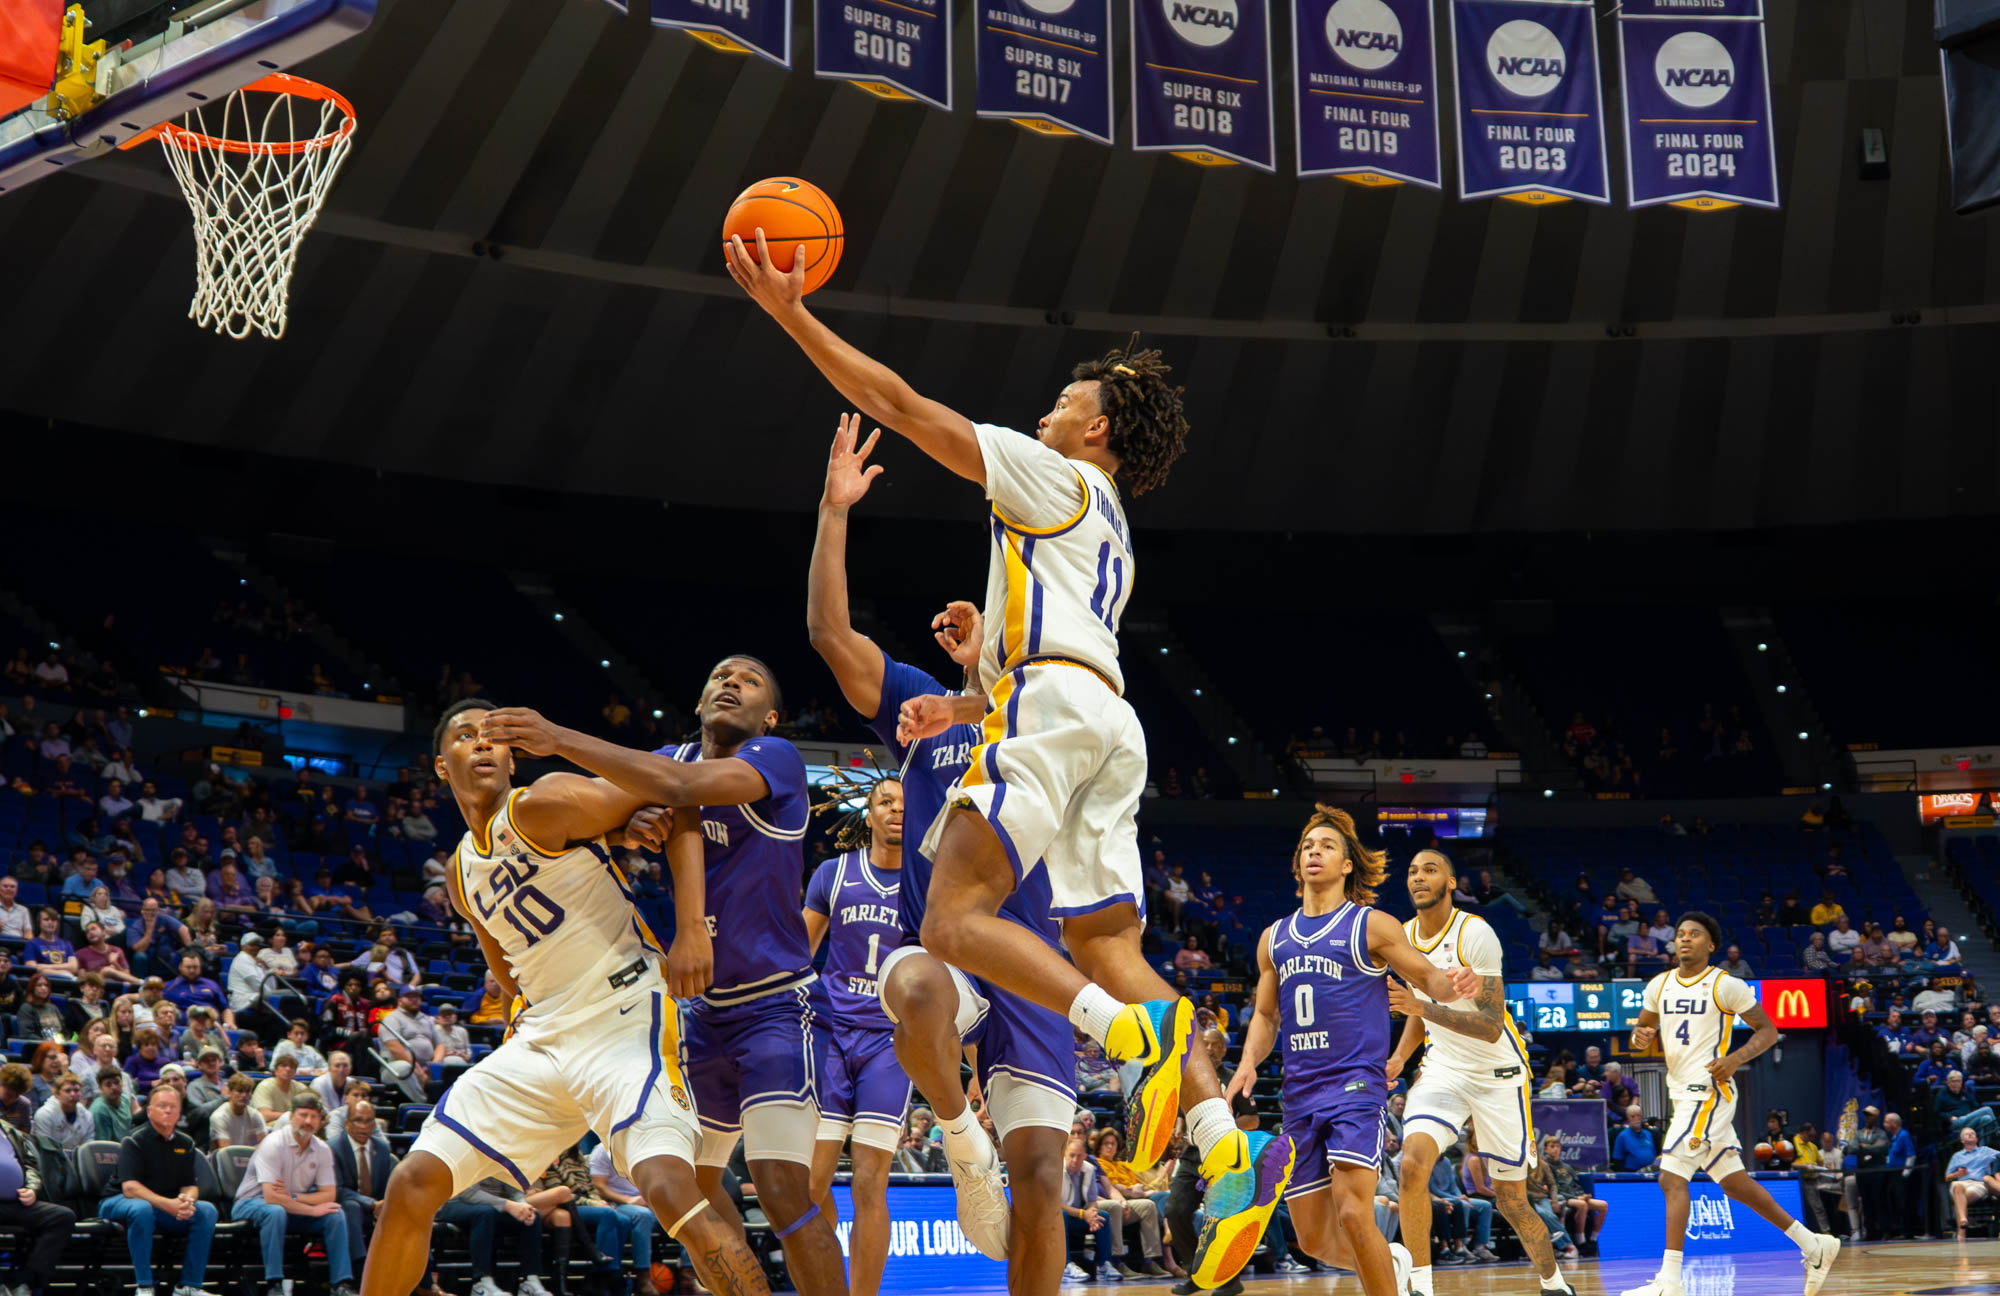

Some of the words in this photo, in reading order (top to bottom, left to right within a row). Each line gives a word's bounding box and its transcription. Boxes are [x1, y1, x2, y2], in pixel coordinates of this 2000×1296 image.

[844, 5, 892, 33] SUPER
[895, 20, 920, 39] SIX
[988, 9, 1037, 30] NATIONAL
[1040, 22, 1097, 44] RUNNER-UP
[1172, 3, 1236, 31] NCAA
[854, 30, 911, 67] 2016
[1335, 28, 1402, 52] NCAA
[1004, 46, 1053, 71] SUPER
[1057, 58, 1081, 78] SIX
[1497, 56, 1564, 78] NCAA
[1016, 70, 1071, 103] 2017
[1310, 72, 1360, 88] NATIONAL
[1363, 78, 1422, 93] RUNNER-UP
[1665, 68, 1733, 88] NCAA
[1163, 81, 1212, 102] SUPER
[1217, 90, 1241, 108] SIX
[1174, 104, 1233, 135] 2018
[1324, 105, 1367, 123] FINAL
[1372, 111, 1411, 128] FOUR
[1339, 127, 1398, 154] 2019
[1487, 125, 1530, 141] FINAL
[1535, 127, 1576, 143] FOUR
[1656, 133, 1699, 149] FINAL
[1704, 134, 1745, 149] FOUR
[1500, 145, 1567, 171] 2023
[1668, 154, 1736, 177] 2024
[1090, 540, 1122, 634] 11
[932, 742, 975, 770] TAR
[474, 854, 539, 921] LSU
[504, 884, 566, 948] 10
[840, 904, 903, 932] TARLET
[865, 933, 880, 975] 1
[848, 977, 878, 998] STAT
[1587, 994, 1598, 1008] 9
[1295, 984, 1315, 1026] 0
[1664, 999, 1707, 1015] LSU
[1290, 1031, 1330, 1052] STATE
[1676, 1020, 1689, 1046] 4
